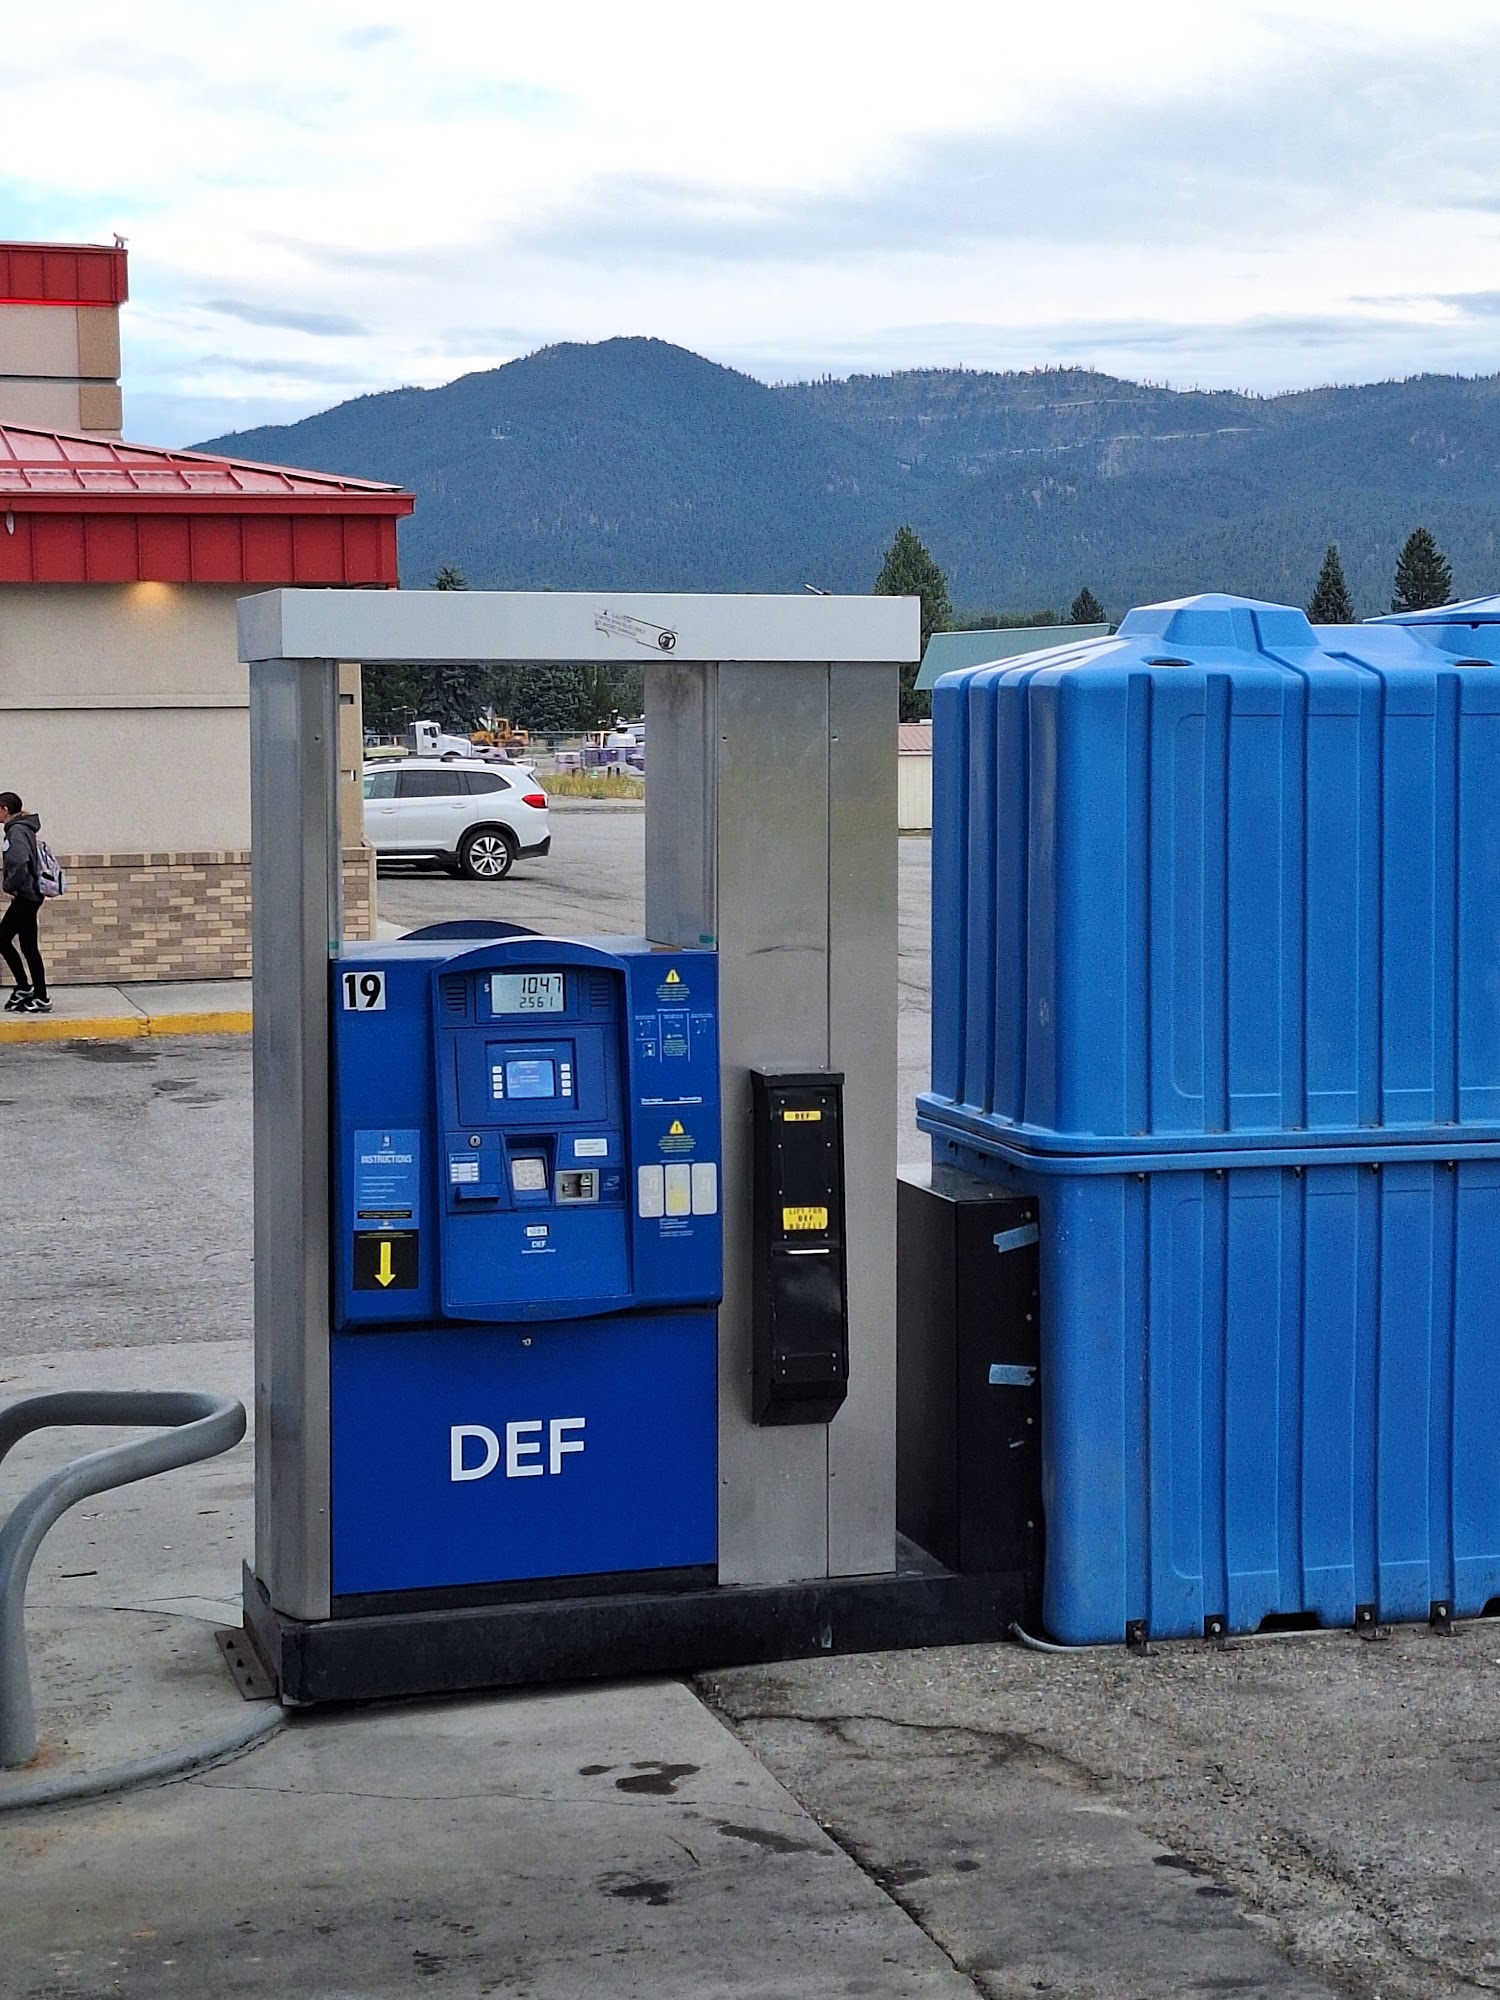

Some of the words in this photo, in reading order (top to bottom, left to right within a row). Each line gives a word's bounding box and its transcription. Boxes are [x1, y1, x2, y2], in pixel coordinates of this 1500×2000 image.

[344, 974, 382, 1008] 19
[794, 1112, 810, 1120] DEF
[797, 1214, 813, 1223] DEF
[451, 1417, 586, 1482] DEF
